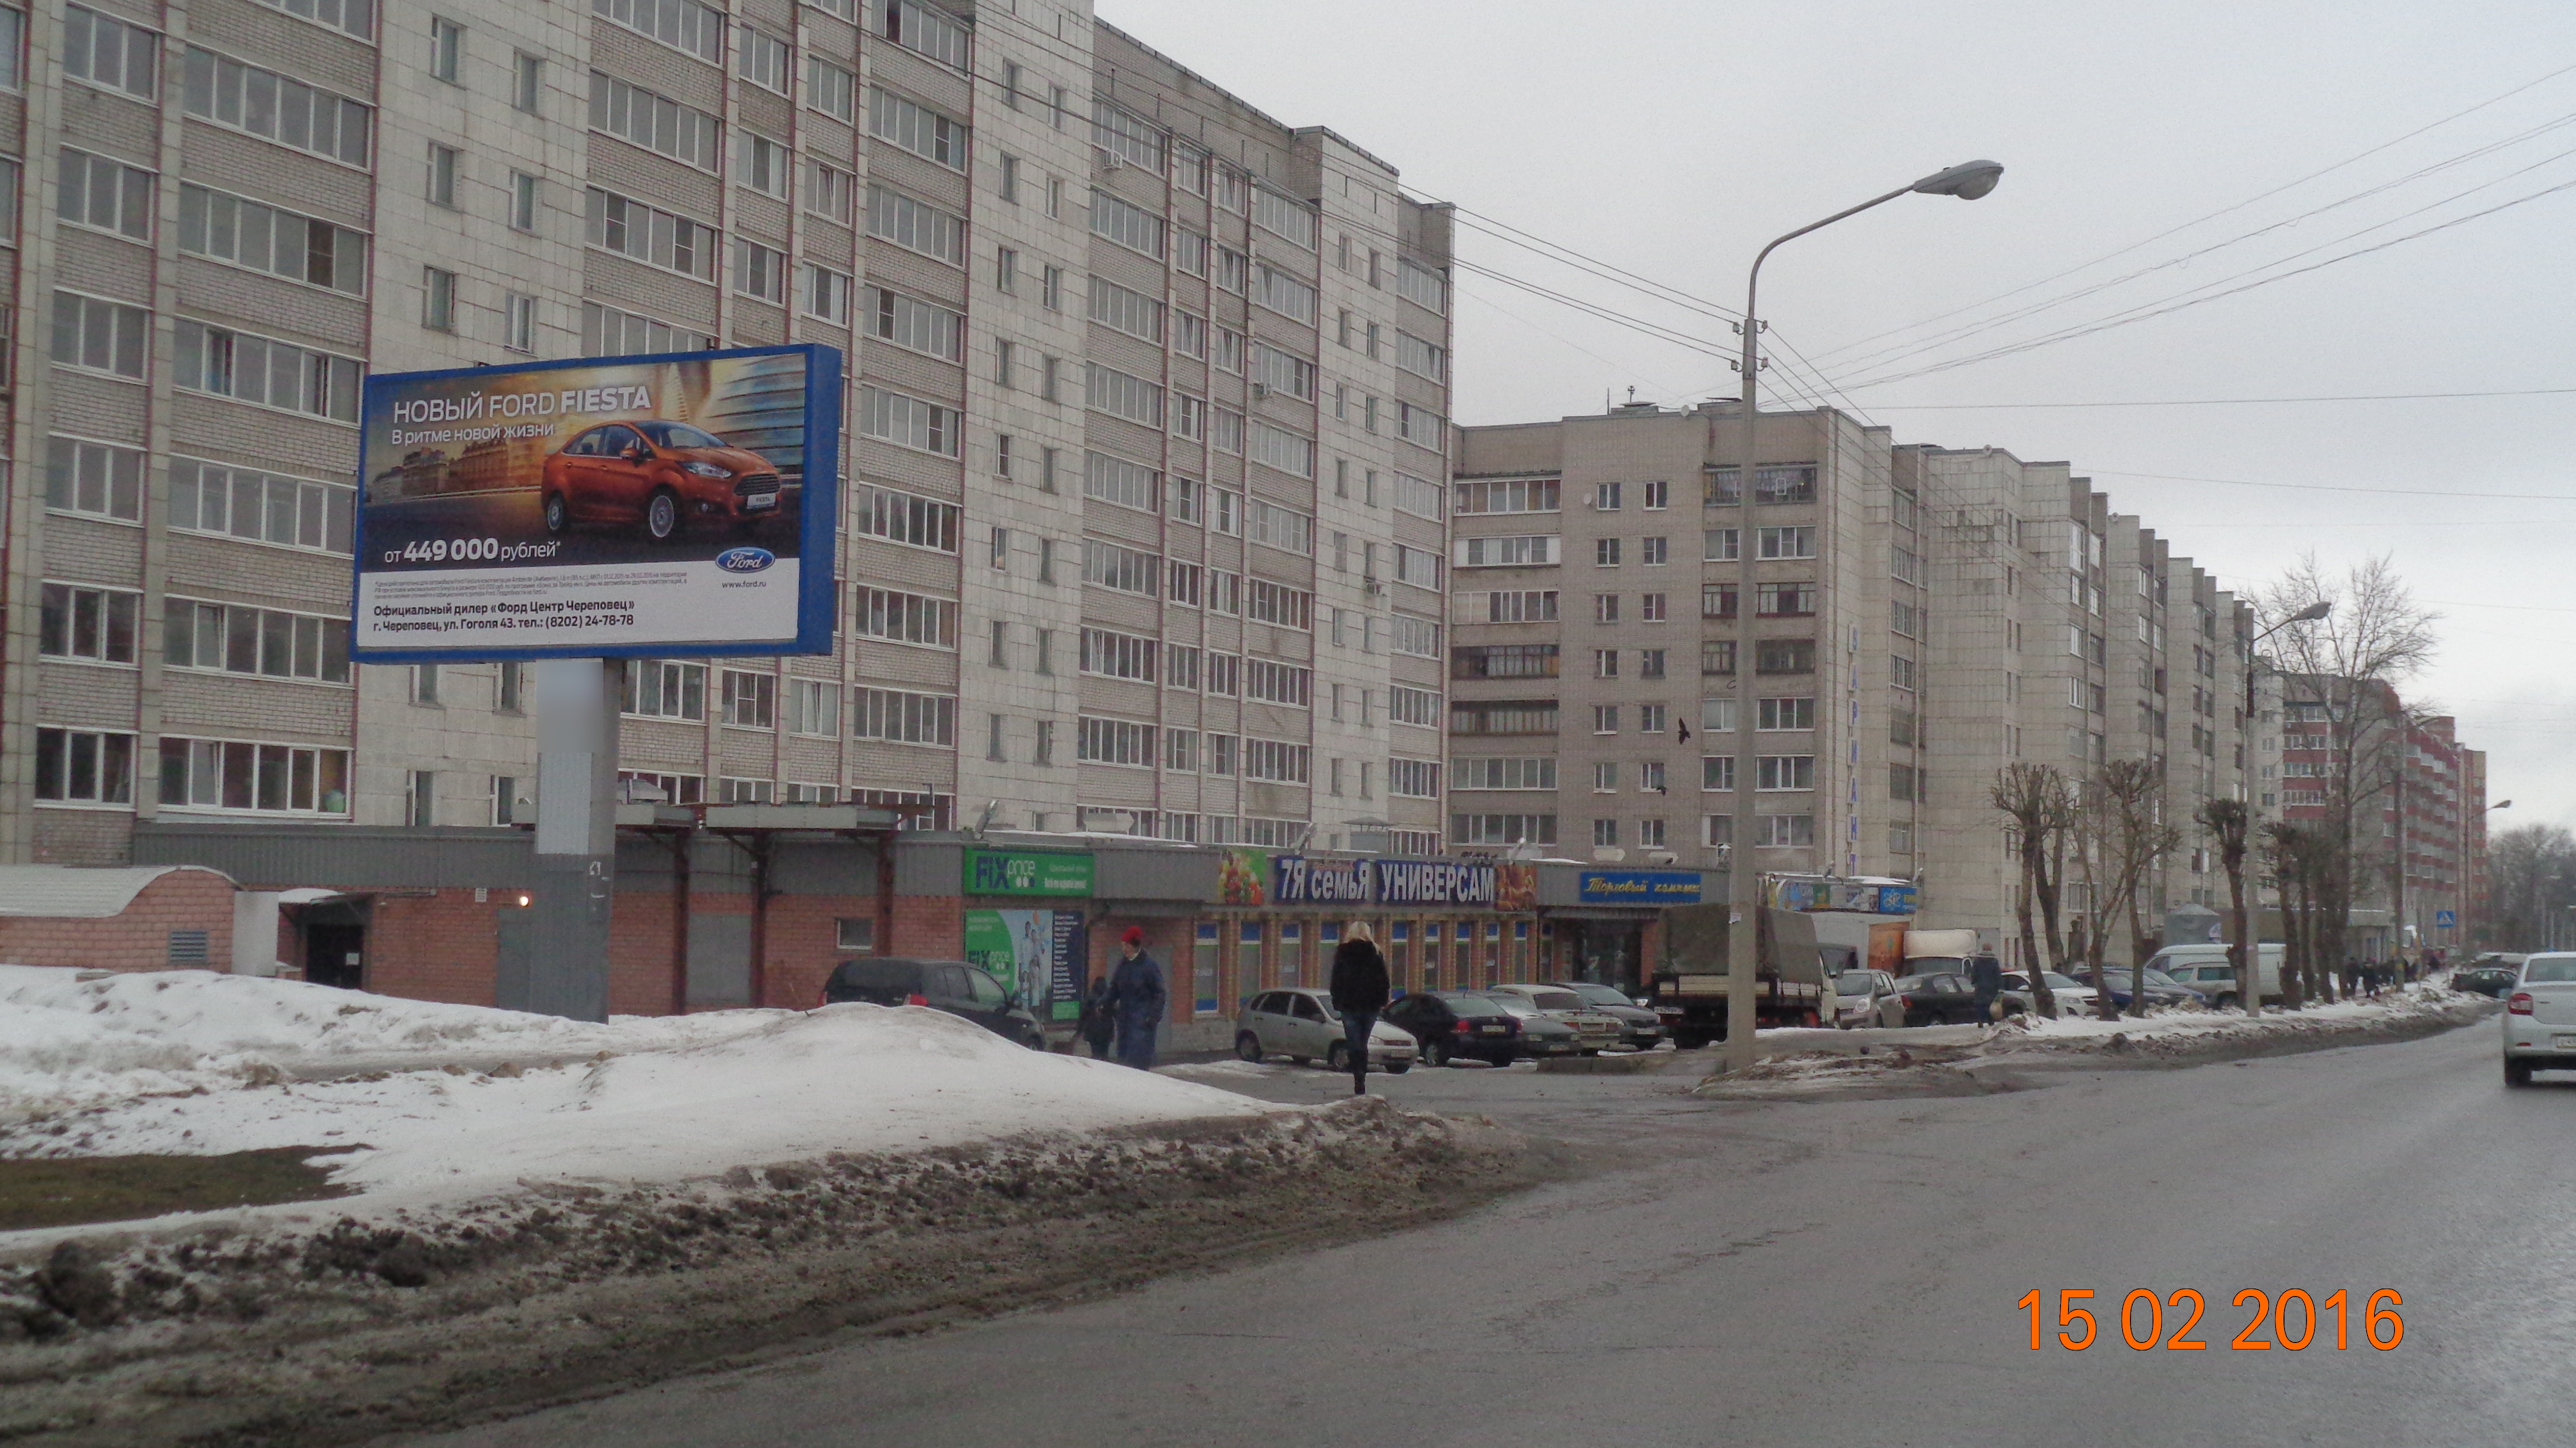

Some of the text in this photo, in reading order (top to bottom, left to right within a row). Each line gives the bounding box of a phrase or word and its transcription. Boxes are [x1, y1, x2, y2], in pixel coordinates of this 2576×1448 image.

[394, 386, 651, 424] НОВЫЙ FORD FIESTA
[392, 423, 554, 446] В ритме новой жизни
[384, 550, 402, 563] от
[404, 540, 447, 562] 449
[450, 538, 499, 561] 000
[727, 551, 763, 569] Ford
[722, 580, 766, 588] www.ford.ru
[374, 602, 452, 618] Официальный
[454, 604, 488, 616] дилер
[530, 601, 564, 614] Центр
[566, 600, 634, 613] Череповец»
[374, 614, 634, 632] г. Череповец, ул. Гоголя 43. тел.: (8202) 24-78-78
[1007, 860, 1036, 878] price
[1282, 859, 1306, 899] 7Я
[1381, 863, 1494, 902] УНИВЕРСАМ
[1584, 877, 1700, 896] Торговый комплек
